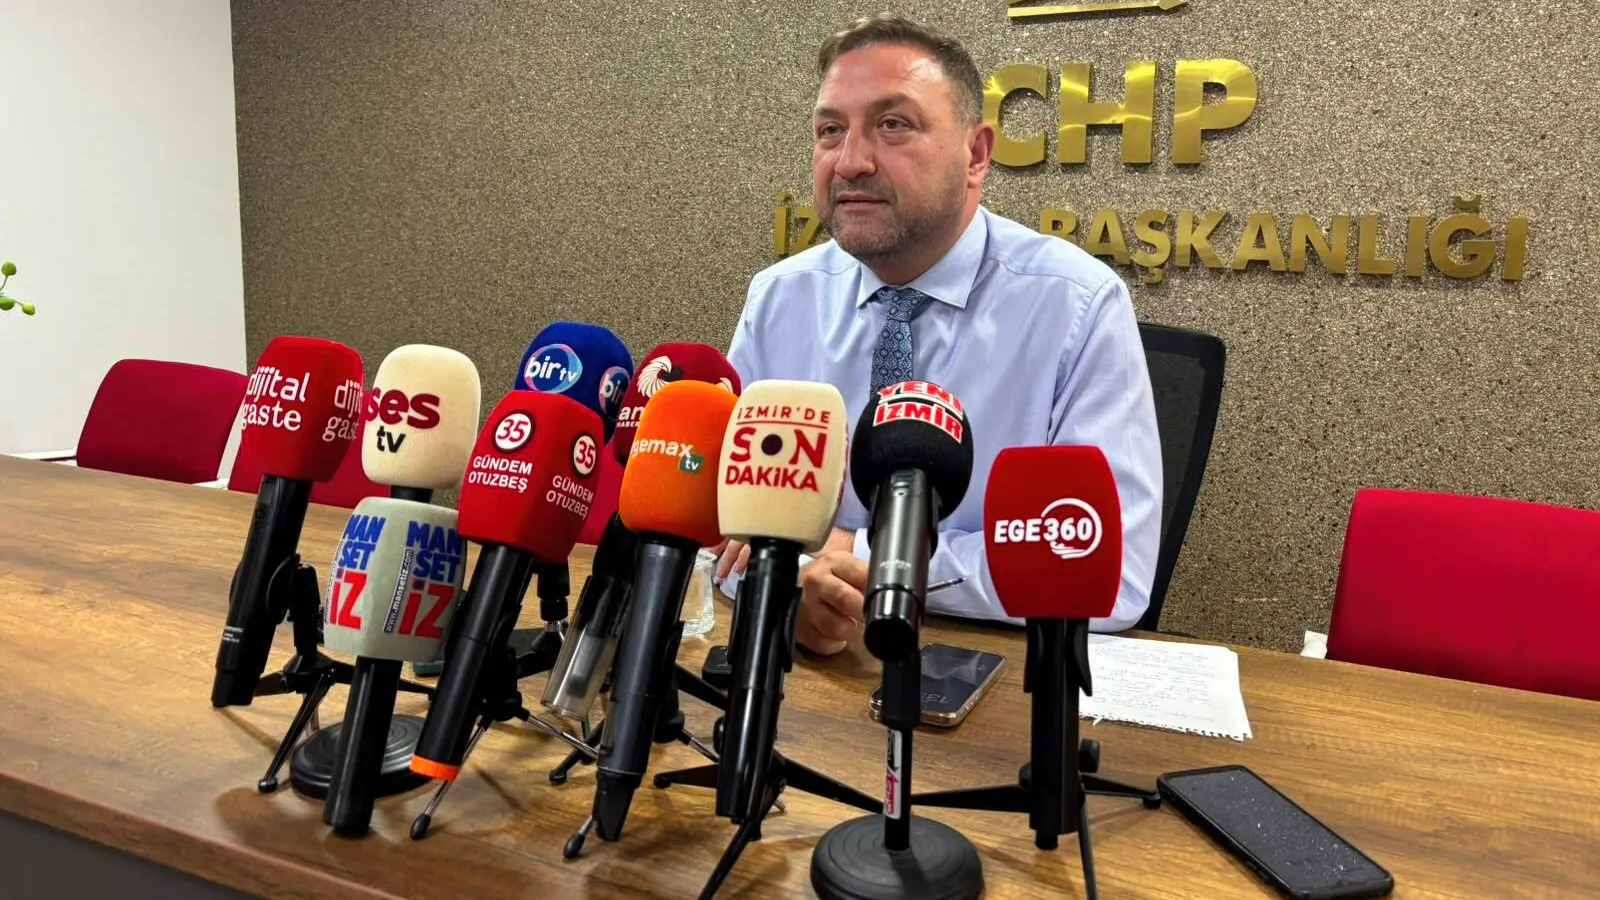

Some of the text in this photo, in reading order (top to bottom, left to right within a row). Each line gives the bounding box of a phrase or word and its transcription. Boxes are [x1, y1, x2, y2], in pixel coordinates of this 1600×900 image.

[977, 58, 1258, 167] CHP
[1039, 195, 1530, 284] BAŞKANLIĞI
[524, 355, 578, 382] bir tv
[246, 366, 311, 403] dijital
[241, 401, 302, 431] gaste
[365, 387, 441, 430] ses
[618, 406, 645, 421] an
[737, 406, 831, 424] İZMİR'DE
[322, 416, 359, 442] gas
[376, 425, 406, 453] tv
[497, 419, 529, 442] 35
[575, 440, 596, 469] 35
[631, 439, 693, 458] gemax
[730, 426, 828, 468] SON
[472, 455, 533, 475] GÜNDEM
[685, 457, 700, 470] tv
[468, 471, 528, 493] OTUZBEŞ
[552, 475, 594, 504] GÜNDEM
[545, 490, 589, 520] OTUZBEŞ
[342, 514, 387, 543] MAN
[406, 521, 461, 556] MAN
[994, 516, 1092, 543] EGE360
[338, 540, 377, 570] SET
[413, 549, 460, 583] SET
[385, 548, 414, 632] www.mansetiz.com
